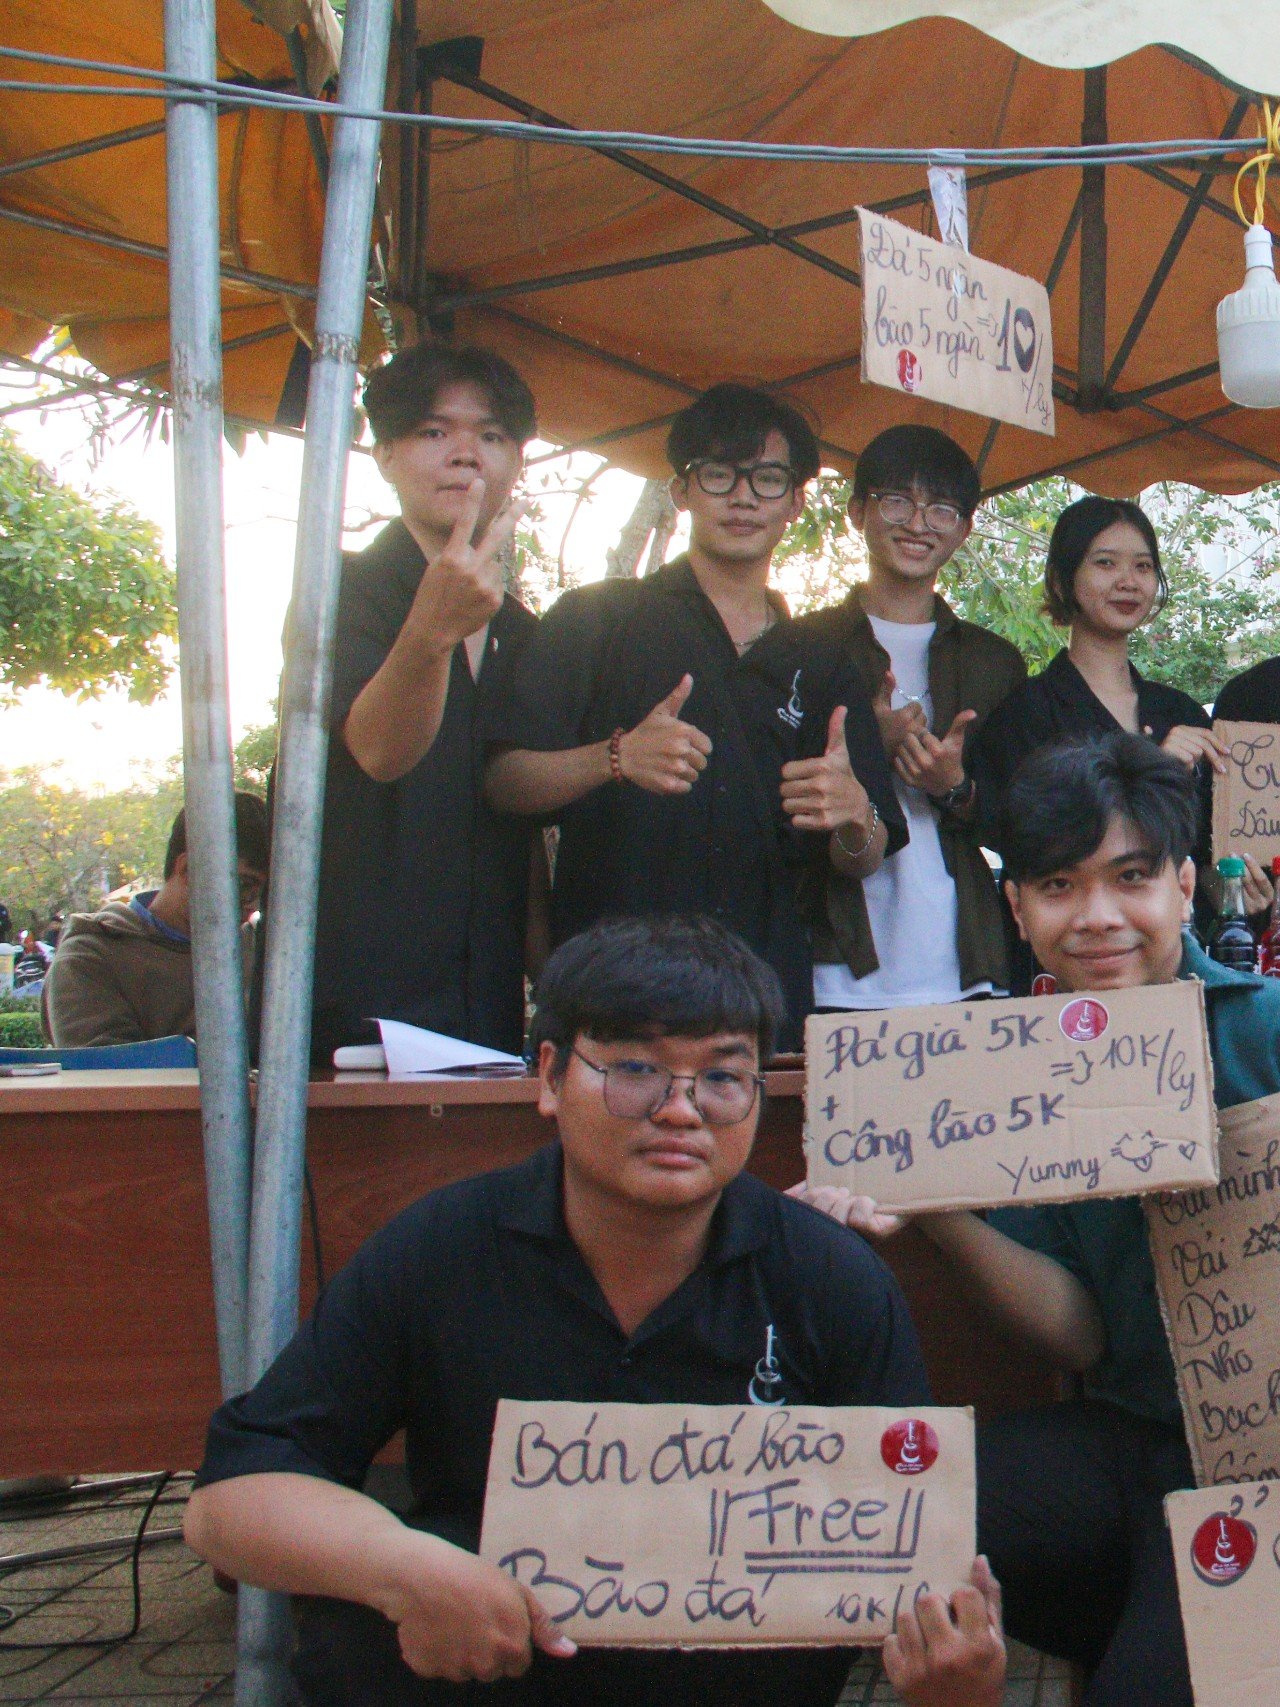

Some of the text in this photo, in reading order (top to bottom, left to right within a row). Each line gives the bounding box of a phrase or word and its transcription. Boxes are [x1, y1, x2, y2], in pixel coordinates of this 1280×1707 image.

[918, 248, 932, 282] 5
[918, 308, 932, 347] 5
[824, 1020, 889, 1079] Đá
[1006, 1091, 1066, 1133] 5K
[997, 1153, 1102, 1196] Yummy
[1183, 1341, 1253, 1390] Nho
[510, 1412, 638, 1489] Bán
[650, 1411, 747, 1485] đá
[684, 1560, 777, 1628] đá
